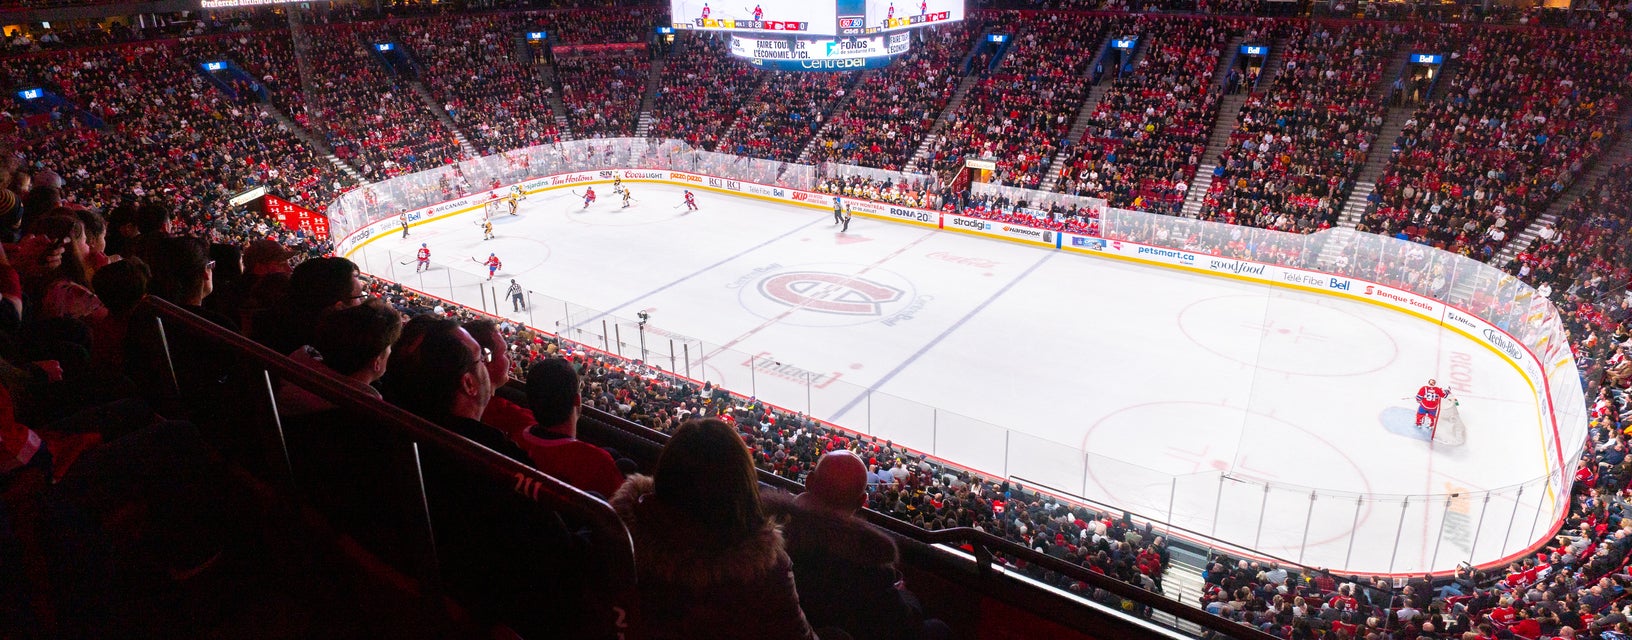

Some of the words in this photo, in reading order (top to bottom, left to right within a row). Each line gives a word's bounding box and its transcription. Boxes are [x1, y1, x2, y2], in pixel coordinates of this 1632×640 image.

[757, 41, 773, 50] FAIRE
[840, 41, 868, 50] FONDS
[1419, 55, 1434, 63] Bell
[208, 63, 220, 71] Bell
[24, 90, 37, 99] Bell
[551, 176, 564, 185] Tim
[565, 174, 593, 184] Hortons
[624, 170, 645, 179] Coors
[670, 172, 686, 181] pizza
[773, 188, 785, 197] Bell
[792, 191, 808, 201] SKIP
[435, 205, 444, 213] AIR
[445, 200, 468, 211] CANADA
[407, 211, 421, 222] Bell
[890, 207, 916, 218] RONA
[953, 216, 985, 231] stradigi
[1138, 245, 1195, 261] petsmart.ca
[1210, 259, 1266, 275] goodfood
[1303, 275, 1324, 287] Fibe
[1329, 277, 1351, 291] Bell
[1376, 289, 1408, 303] Banque
[1409, 298, 1433, 312] Scotia
[1450, 351, 1472, 393] RICOH
